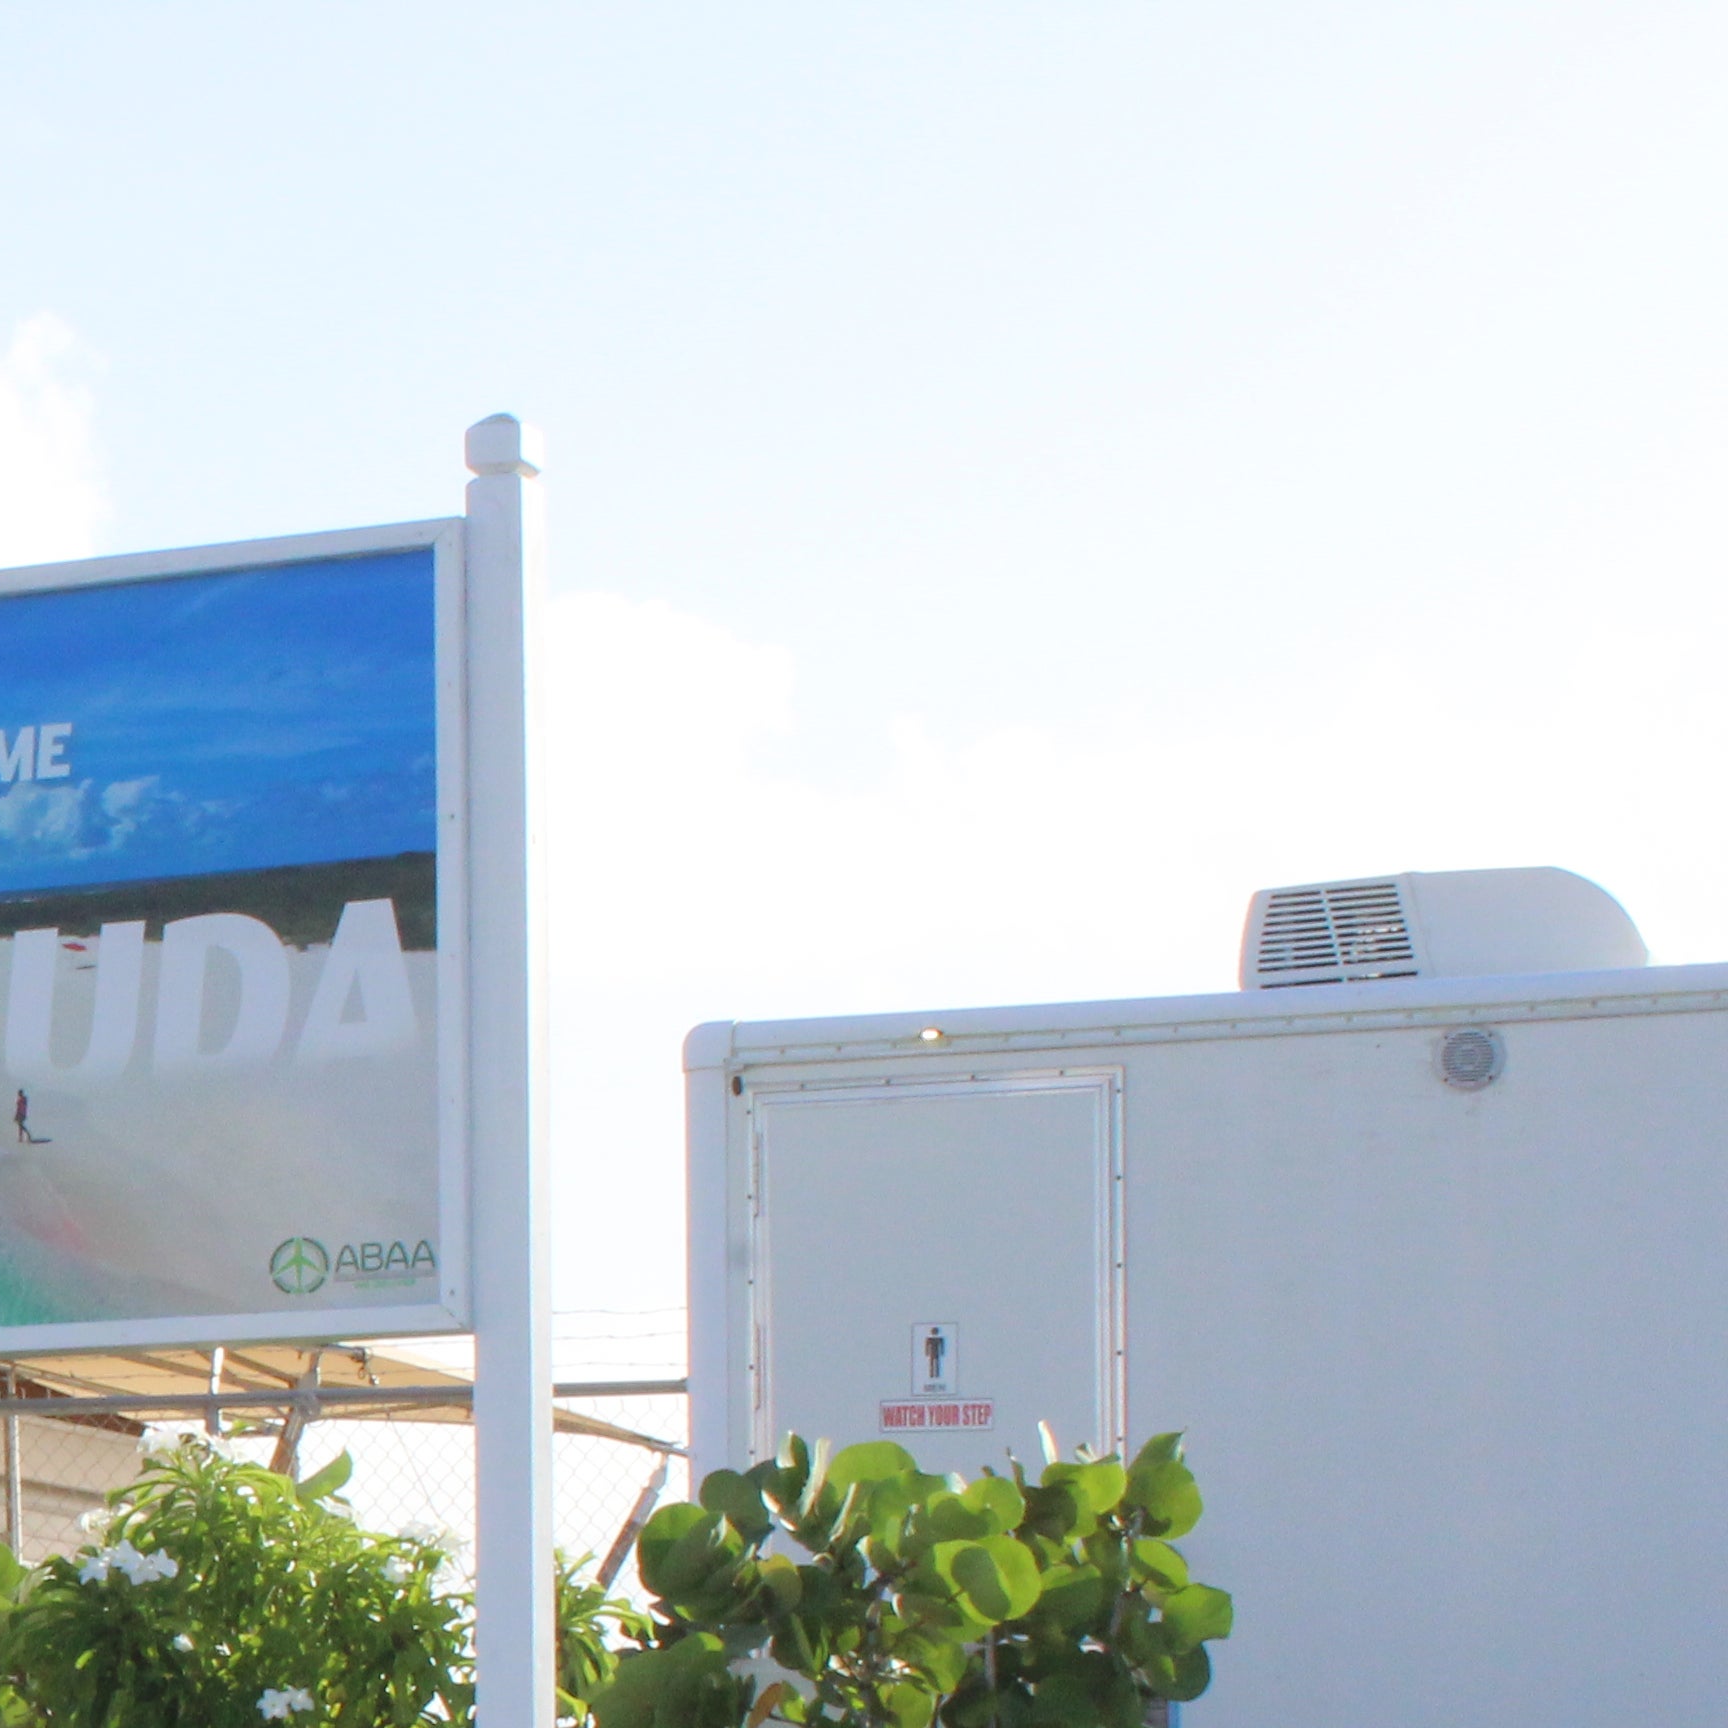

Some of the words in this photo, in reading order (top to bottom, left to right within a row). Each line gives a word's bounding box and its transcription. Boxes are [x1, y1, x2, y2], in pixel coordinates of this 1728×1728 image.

[335, 1239, 436, 1273] ABAA
[883, 1405, 925, 1427] WATCH
[928, 1404, 959, 1426] YOUR
[962, 1403, 992, 1425] STEP
